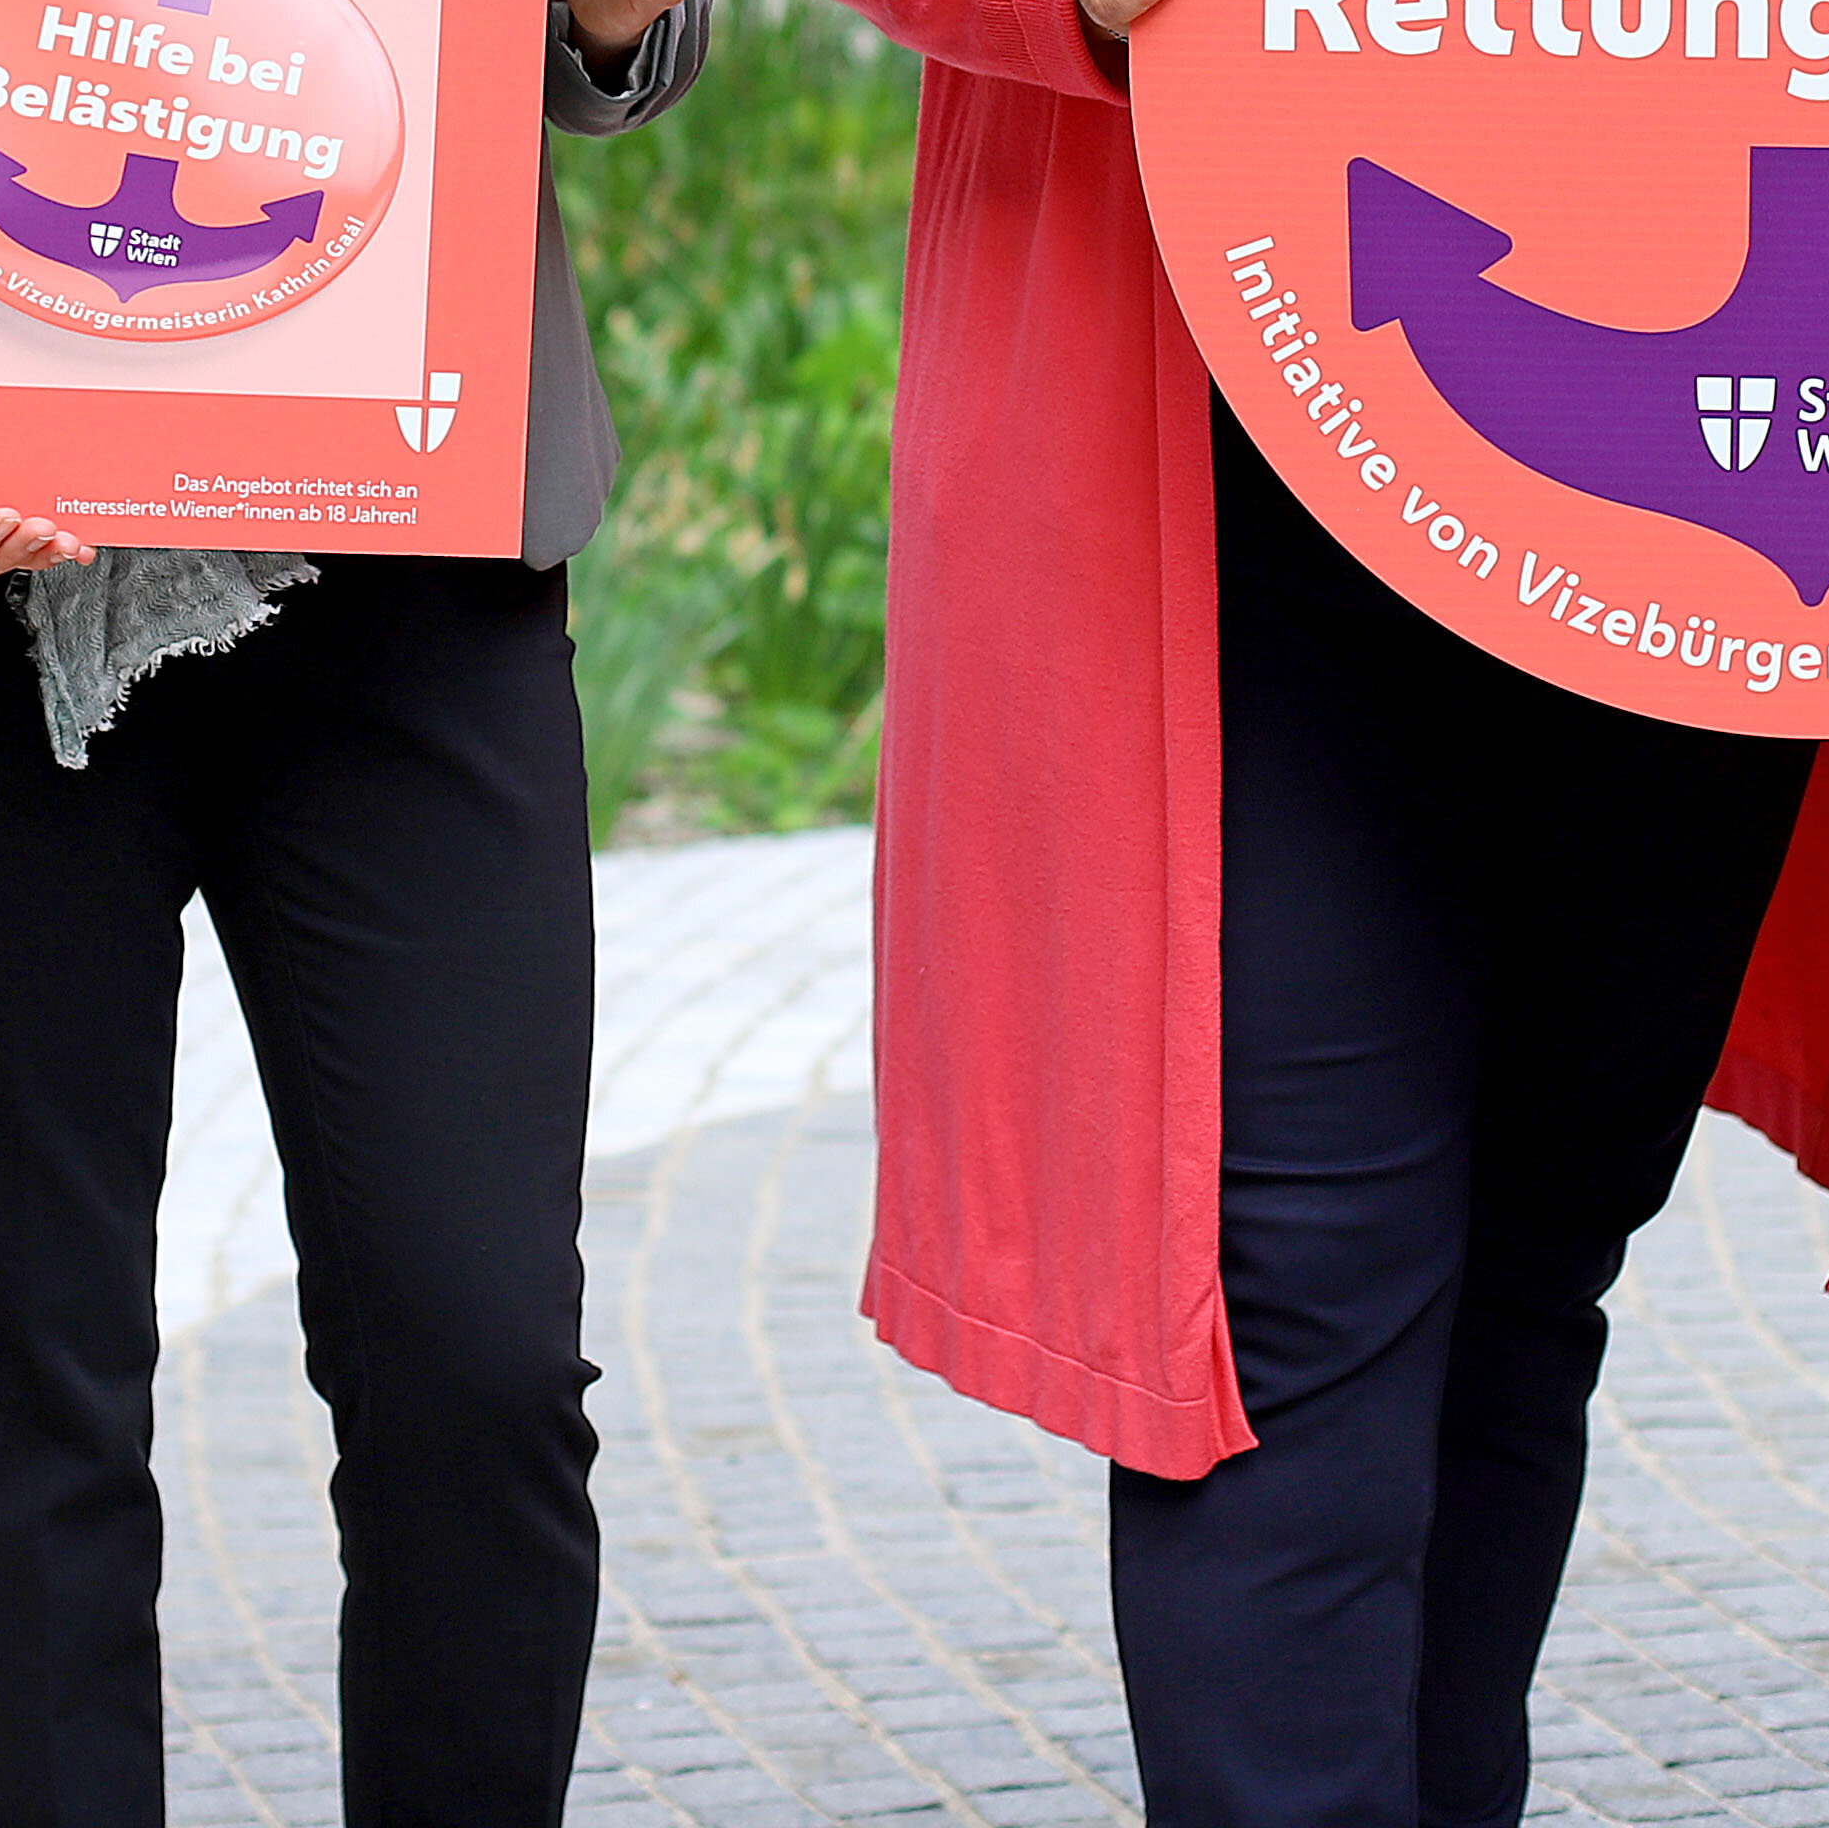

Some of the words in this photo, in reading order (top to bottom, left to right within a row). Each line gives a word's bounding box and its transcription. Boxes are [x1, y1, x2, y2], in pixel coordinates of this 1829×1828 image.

[38, 5, 194, 75] Hilfe
[208, 36, 306, 96] bei
[127, 245, 177, 266] Wien
[129, 229, 181, 253] Stadt
[7, 272, 251, 330] Vizebürgermeisterin
[251, 258, 331, 309] Kathrin
[325, 216, 365, 257] Gaál
[1225, 236, 1396, 500] Initiative
[1402, 485, 1499, 580] von
[174, 473, 209, 493] Das
[211, 475, 293, 499] Angebot
[295, 477, 354, 497] richtet
[356, 479, 392, 498] sich
[394, 485, 418, 499] an
[56, 496, 167, 517] interessierte
[298, 503, 322, 522] ab
[325, 504, 347, 523] 18
[348, 505, 417, 525] Jahren!
